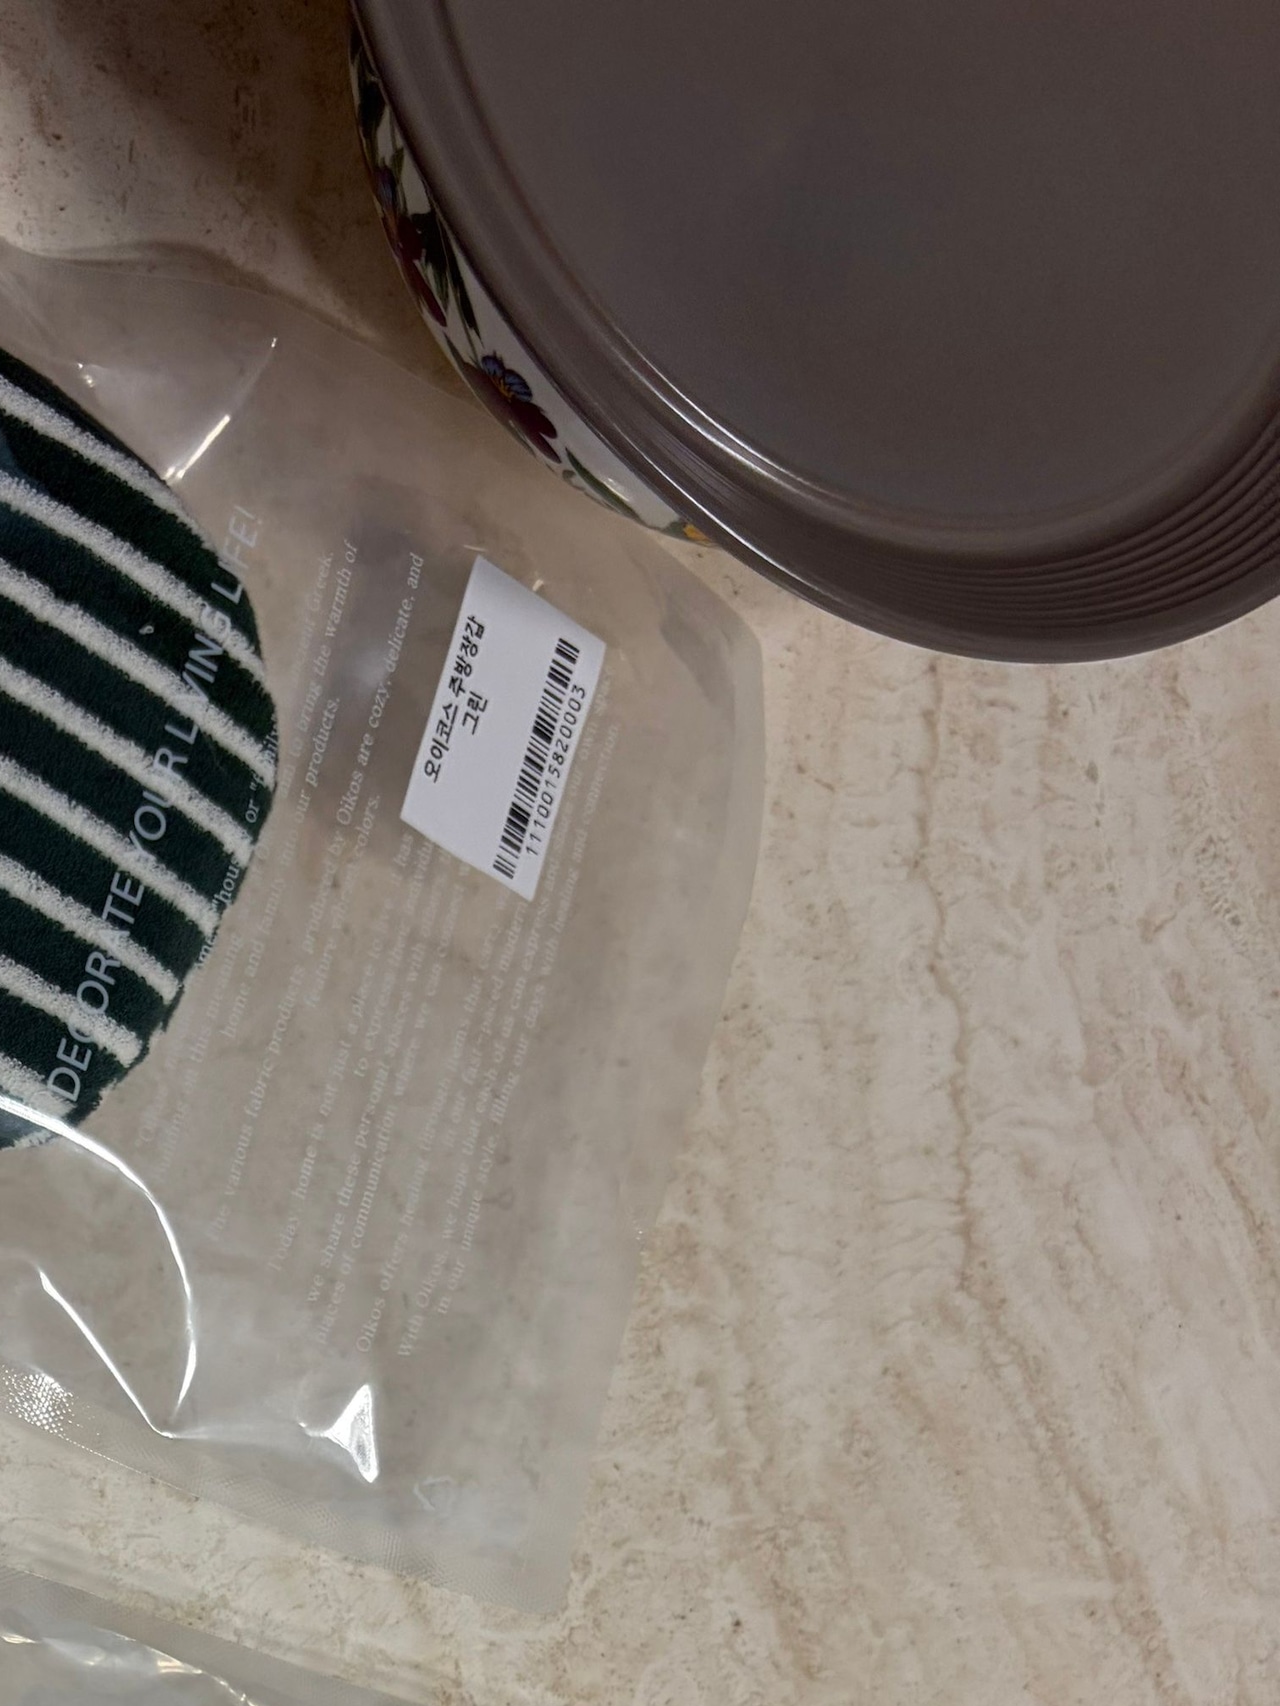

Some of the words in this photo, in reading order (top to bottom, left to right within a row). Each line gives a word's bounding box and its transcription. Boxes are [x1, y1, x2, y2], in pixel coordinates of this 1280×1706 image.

[310, 645, 332, 676] the
[324, 567, 354, 639] warmth
[341, 537, 361, 564] of
[304, 698, 339, 787] products.
[420, 700, 460, 783] 오이코스
[445, 614, 486, 697] 주방장갑
[459, 690, 488, 735] 그린
[47, 870, 144, 1101] DECORATE
[126, 746, 188, 864] YOUR
[164, 604, 232, 746] LIVING
[211, 504, 264, 604] LIFE!
[244, 799, 261, 823] or
[353, 797, 381, 859] colors.
[524, 685, 586, 857] 1110015820003
[225, 1125, 255, 1197] various
[243, 1059, 275, 1118] fabric
[269, 965, 303, 1055] products
[334, 772, 365, 825] Oikos
[355, 732, 376, 766] are
[406, 552, 426, 589] and
[290, 1146, 319, 1199] home
[306, 1272, 325, 1303] we
[320, 1213, 346, 1269] share
[334, 1154, 363, 1208] these
[356, 1059, 389, 1149] personal
[317, 1281, 343, 1346] places
[340, 1252, 355, 1276] of
[348, 1105, 402, 1249] communication
[459, 1190, 484, 1250] unique
[354, 1297, 386, 1354] Oikos
[378, 1231, 408, 1293] offers
[397, 1312, 423, 1358] With
